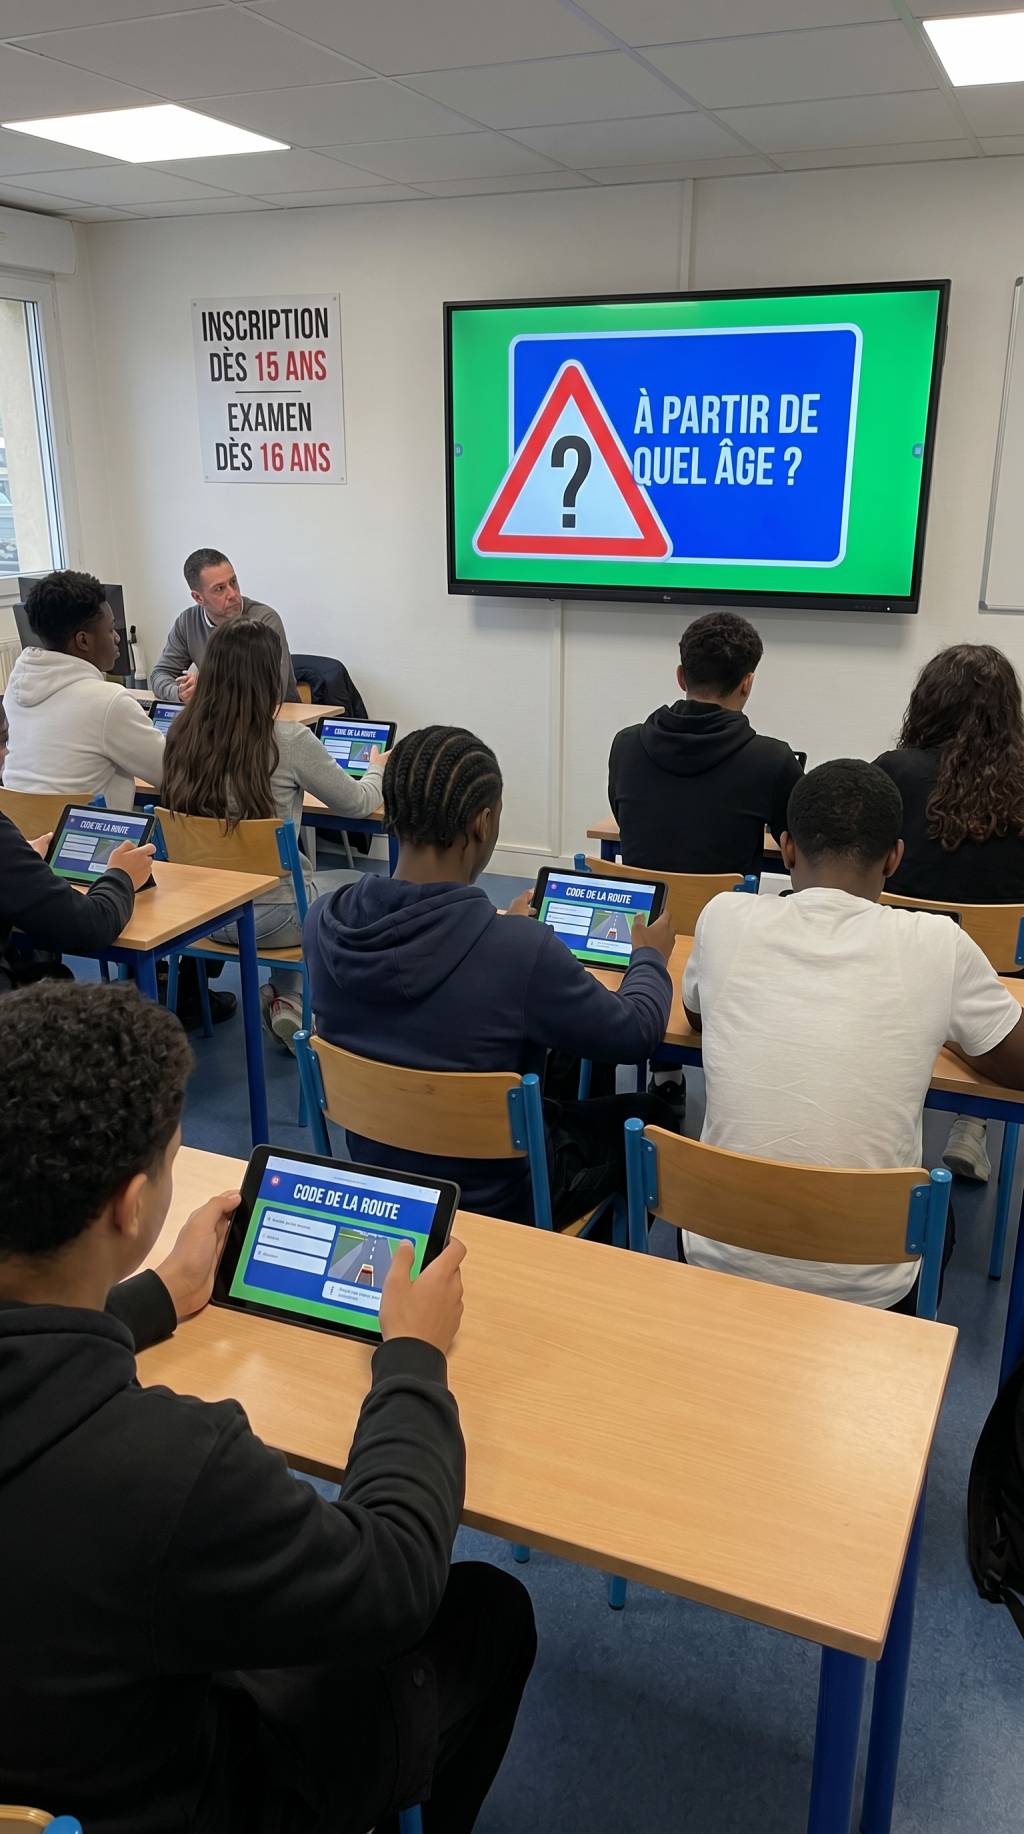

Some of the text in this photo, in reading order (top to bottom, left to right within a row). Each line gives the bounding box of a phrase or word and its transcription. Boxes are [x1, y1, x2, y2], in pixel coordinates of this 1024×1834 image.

[202, 308, 328, 341] INSCRIPTION
[209, 346, 327, 382] DÈS 15 ANS
[228, 402, 312, 432] EXAMEN
[633, 387, 821, 434] À PARTIR DE
[215, 437, 331, 472] DÈS 16 ANS
[633, 438, 803, 486] QUEL ÂGE ?
[103, 823, 110, 831] LA
[566, 887, 632, 904] CODE DE LA ROUTE
[293, 1184, 401, 1220] CODE DE LA ROUTE
